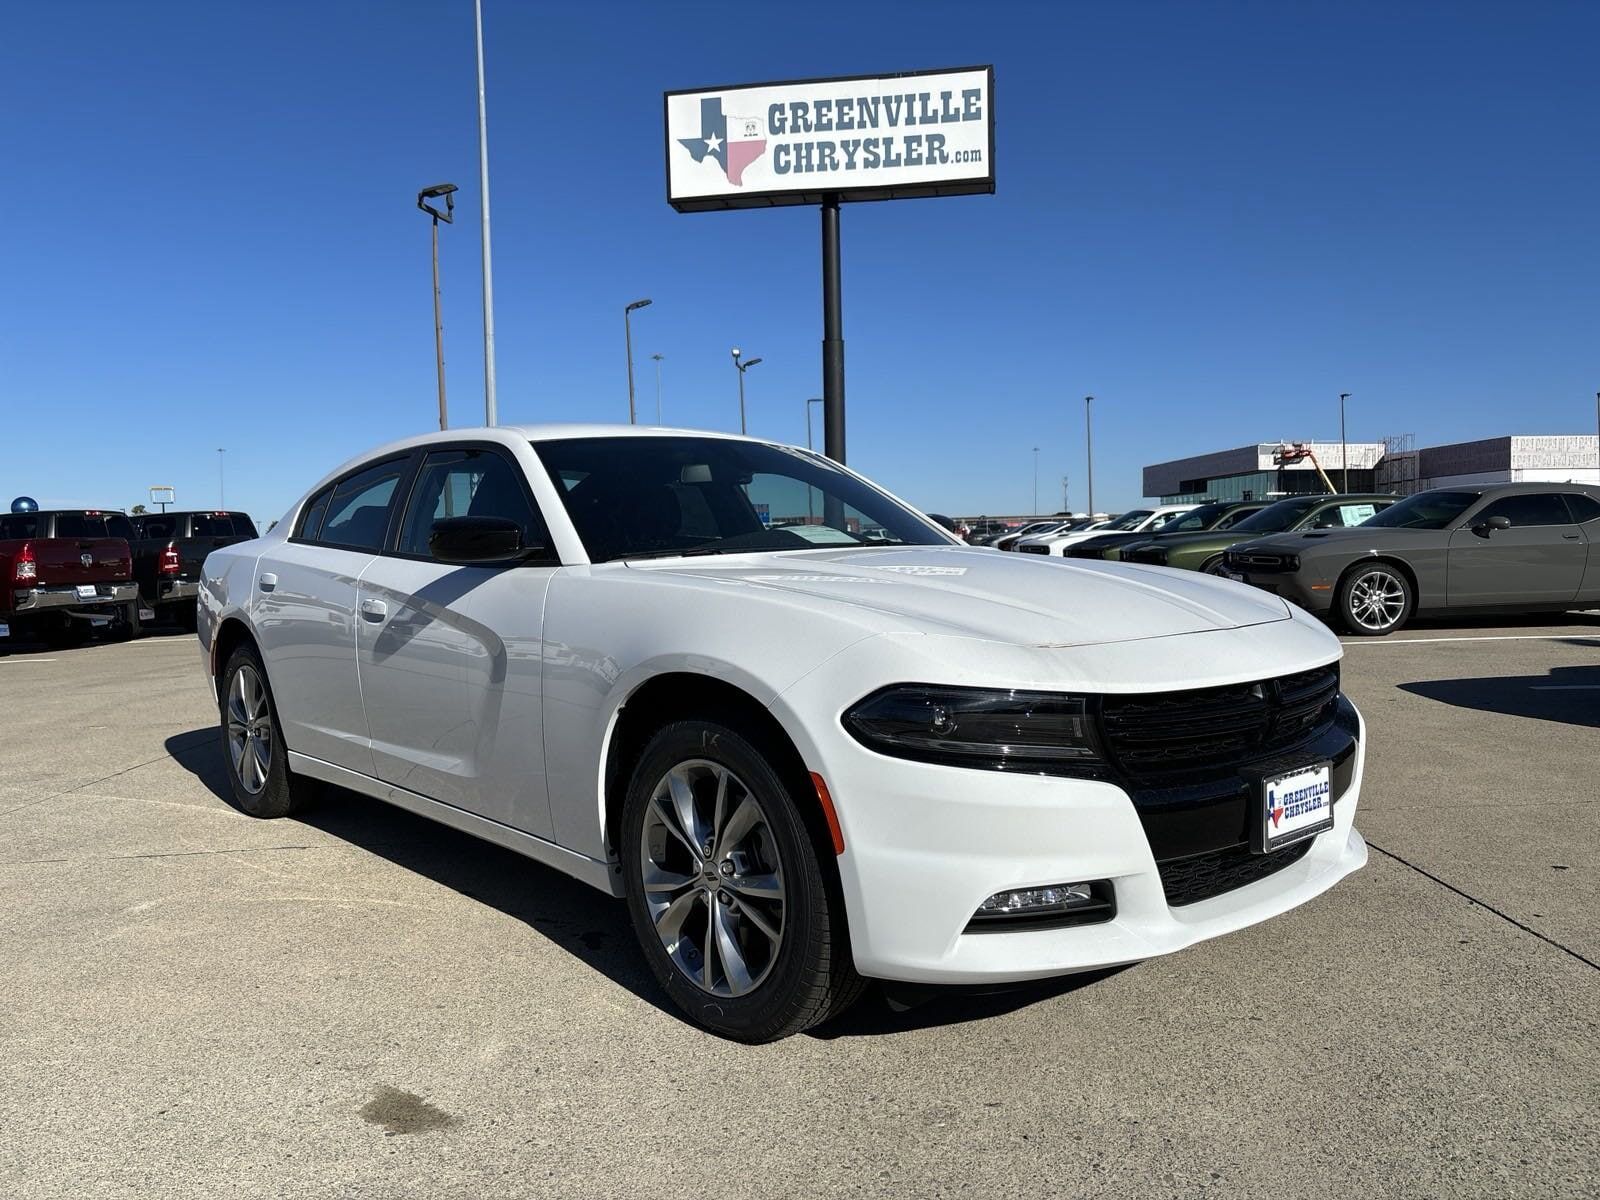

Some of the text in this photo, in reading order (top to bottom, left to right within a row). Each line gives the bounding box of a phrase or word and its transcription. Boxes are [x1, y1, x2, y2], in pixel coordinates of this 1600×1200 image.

[768, 88, 982, 135] GREENVILLE
[1283, 781, 1329, 806] GREENVILLE
[1284, 797, 1329, 819] CHRYSLER
